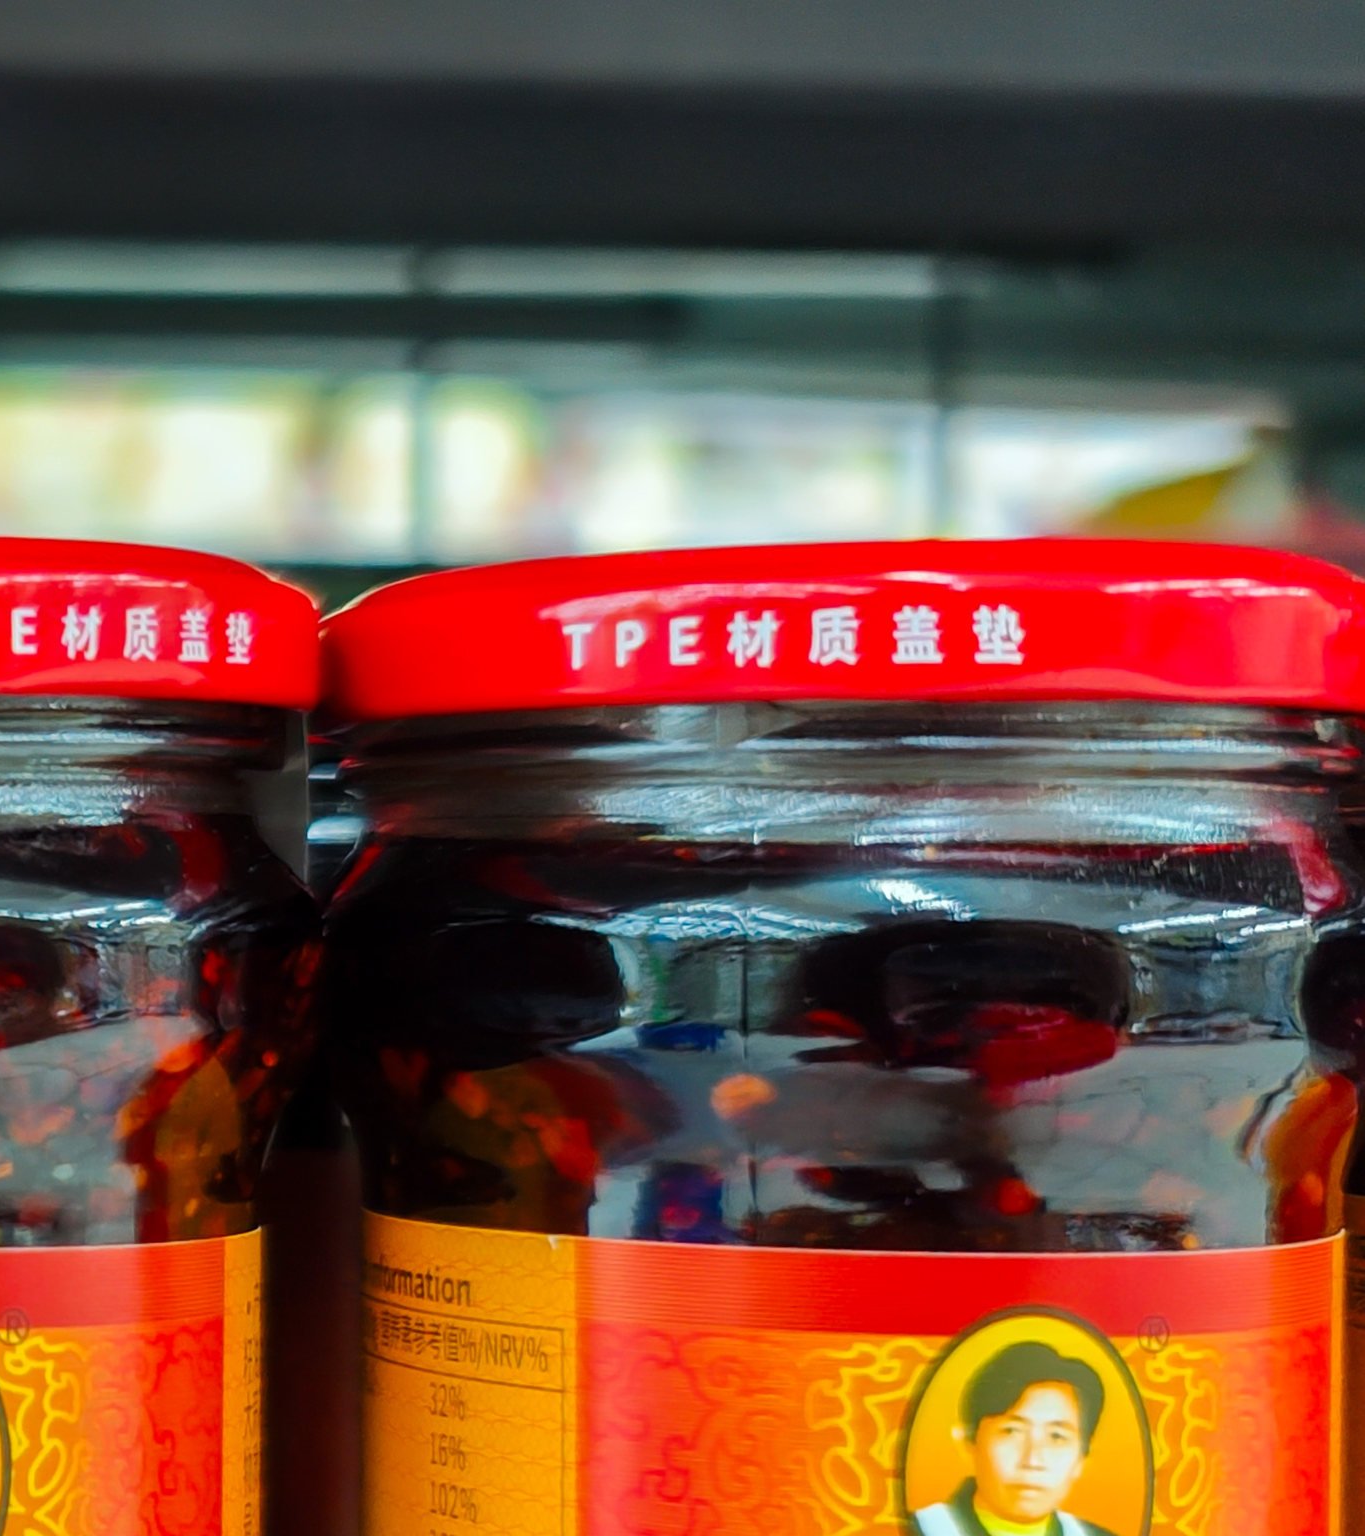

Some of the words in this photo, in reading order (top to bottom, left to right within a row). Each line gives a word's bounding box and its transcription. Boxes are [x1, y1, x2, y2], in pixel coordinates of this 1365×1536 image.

[429, 1381, 466, 1421] 32%
[429, 1431, 466, 1471] 16%
[430, 1481, 477, 1524] 102%
